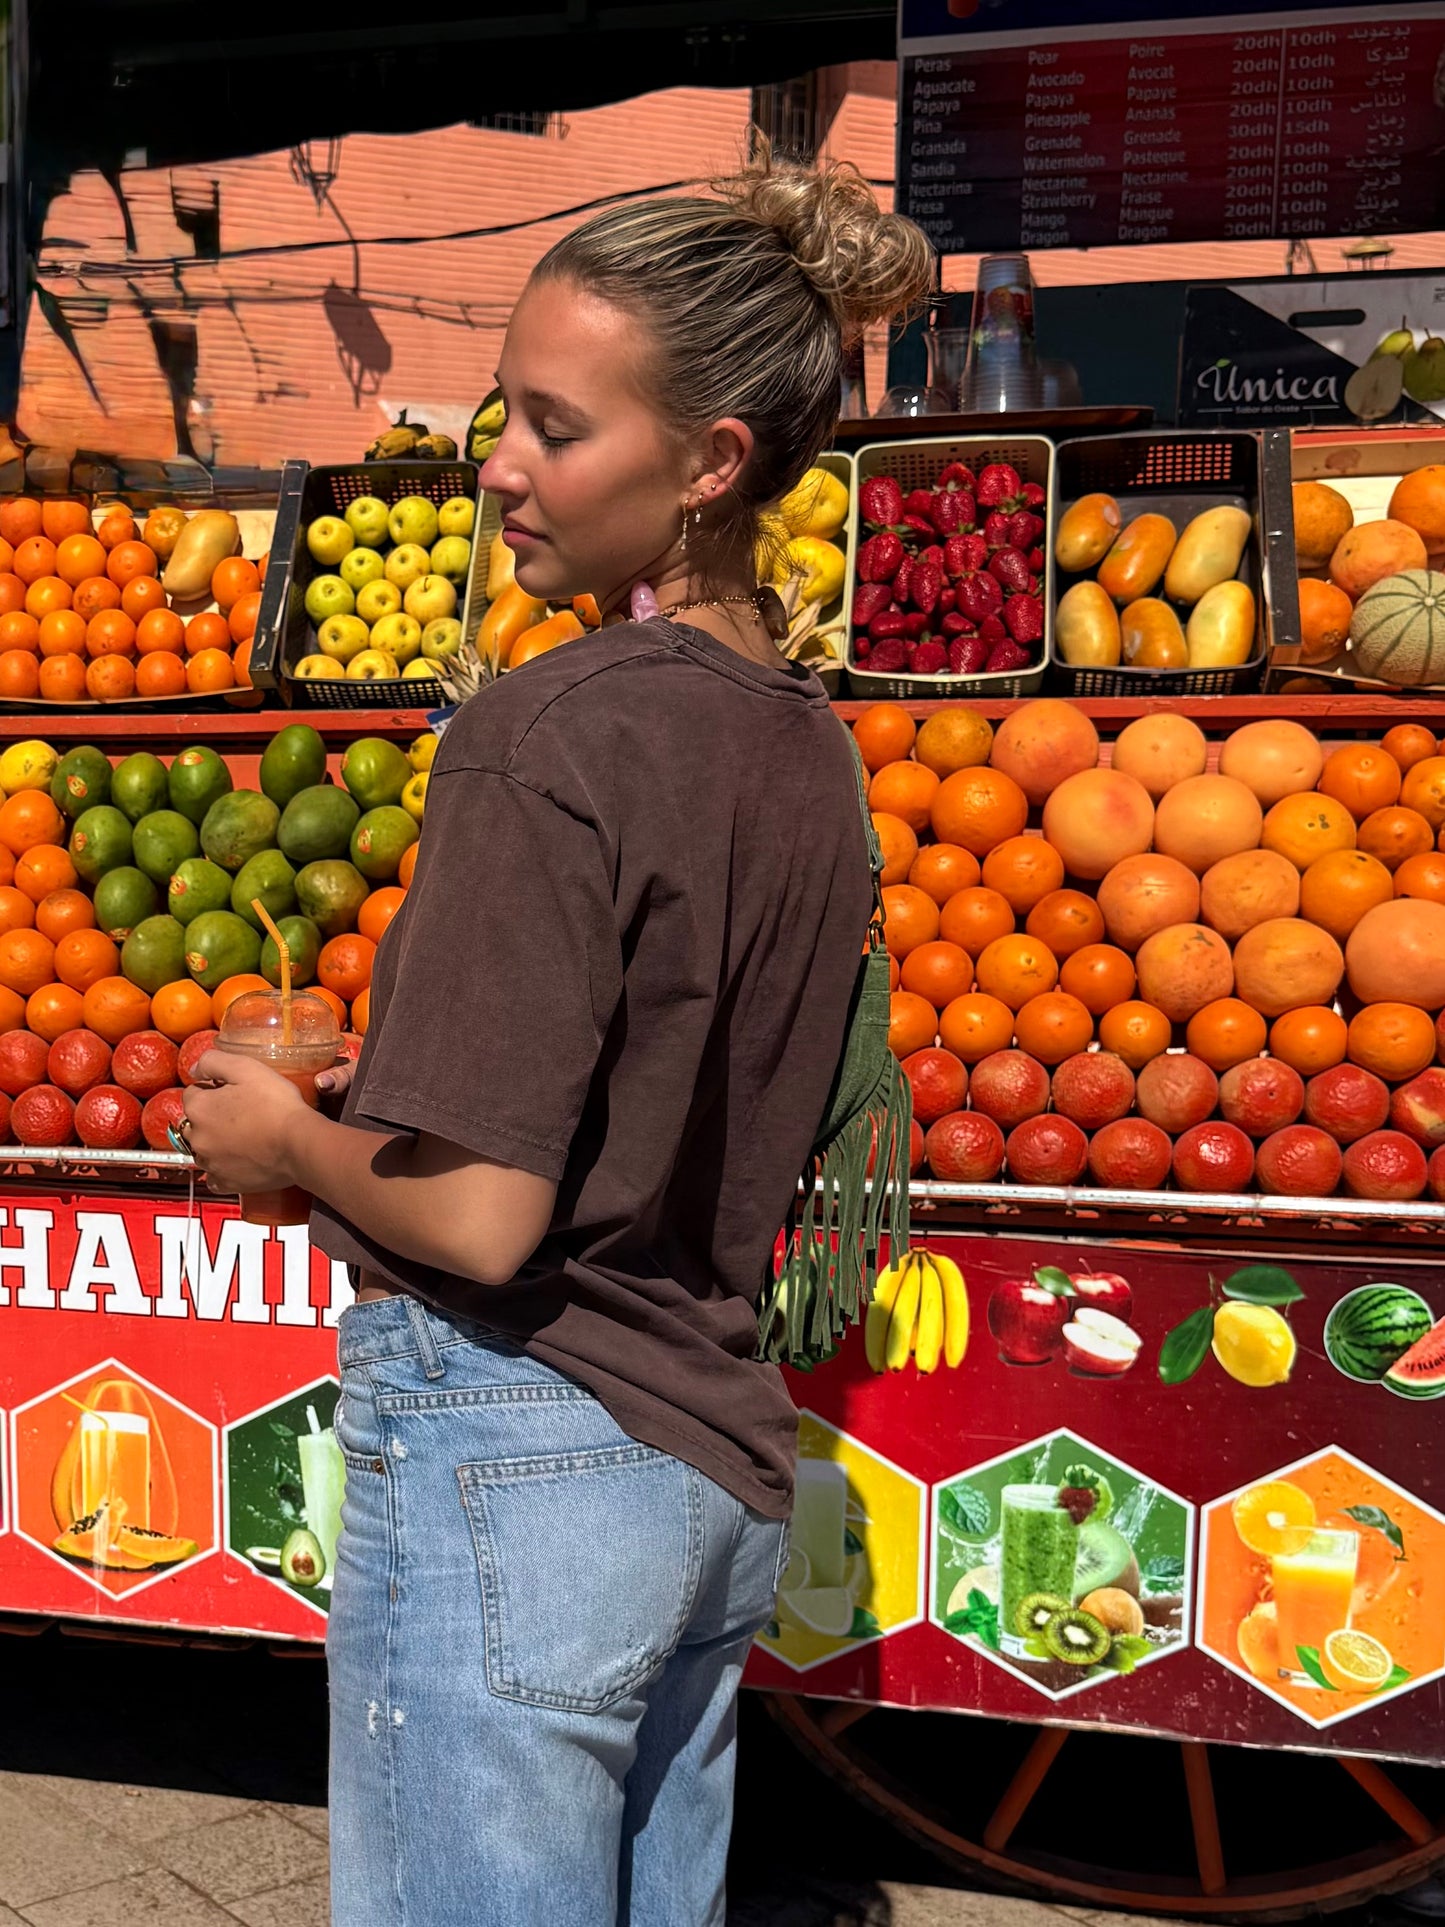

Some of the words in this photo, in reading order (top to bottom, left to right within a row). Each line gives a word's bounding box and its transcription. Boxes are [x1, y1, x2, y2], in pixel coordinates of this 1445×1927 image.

[1232, 35, 1281, 51] 20dh
[1290, 30, 1336, 47] 10dh
[1028, 50, 1059, 65] Pear
[1129, 44, 1165, 58] Poire
[915, 58, 952, 73] Peras
[1232, 58, 1279, 74] 20dh
[1288, 53, 1335, 70] 10dh
[1028, 71, 1085, 88] Avocado
[1128, 65, 1175, 80] Avocat
[914, 79, 976, 99] Aguacate
[1230, 81, 1278, 95] 20dh
[1287, 77, 1334, 92] 10dh
[1025, 93, 1075, 110] Papaya
[1127, 86, 1177, 103] Papaye
[913, 99, 961, 116] Papaya
[1126, 107, 1176, 122] Ananas
[1229, 103, 1277, 117] 20dh
[1285, 99, 1333, 115] 10dh
[1025, 112, 1091, 128] Pineapple
[1284, 120, 1330, 135] 15dh
[1124, 130, 1183, 145] Grenade
[1227, 123, 1274, 138] 30dh
[911, 140, 966, 157] Granada
[1025, 135, 1082, 151] Grenade
[1283, 142, 1330, 157] 10dh
[1227, 145, 1274, 160] 20dh
[1023, 153, 1106, 171] Watermelon
[1282, 162, 1329, 176] 10dh
[1122, 170, 1188, 186] Nectarine
[1226, 164, 1273, 179] 20dh
[909, 182, 973, 197] Nectarina
[1022, 176, 1088, 192] Nectarine
[1225, 184, 1273, 199] 20dh
[1281, 180, 1328, 195] 10dh
[1021, 193, 1097, 210] Strawberry
[1121, 189, 1163, 205] Fraise
[909, 201, 944, 215] Fresa
[1225, 202, 1271, 217] 20dh
[1280, 199, 1327, 214] 10dh
[1021, 213, 1066, 230] Mango
[1120, 208, 1174, 224] Mangue
[921, 218, 953, 234] ango
[1118, 226, 1168, 242] Dragon
[1281, 218, 1326, 234] 15dh
[1020, 231, 1070, 247] Dragon
